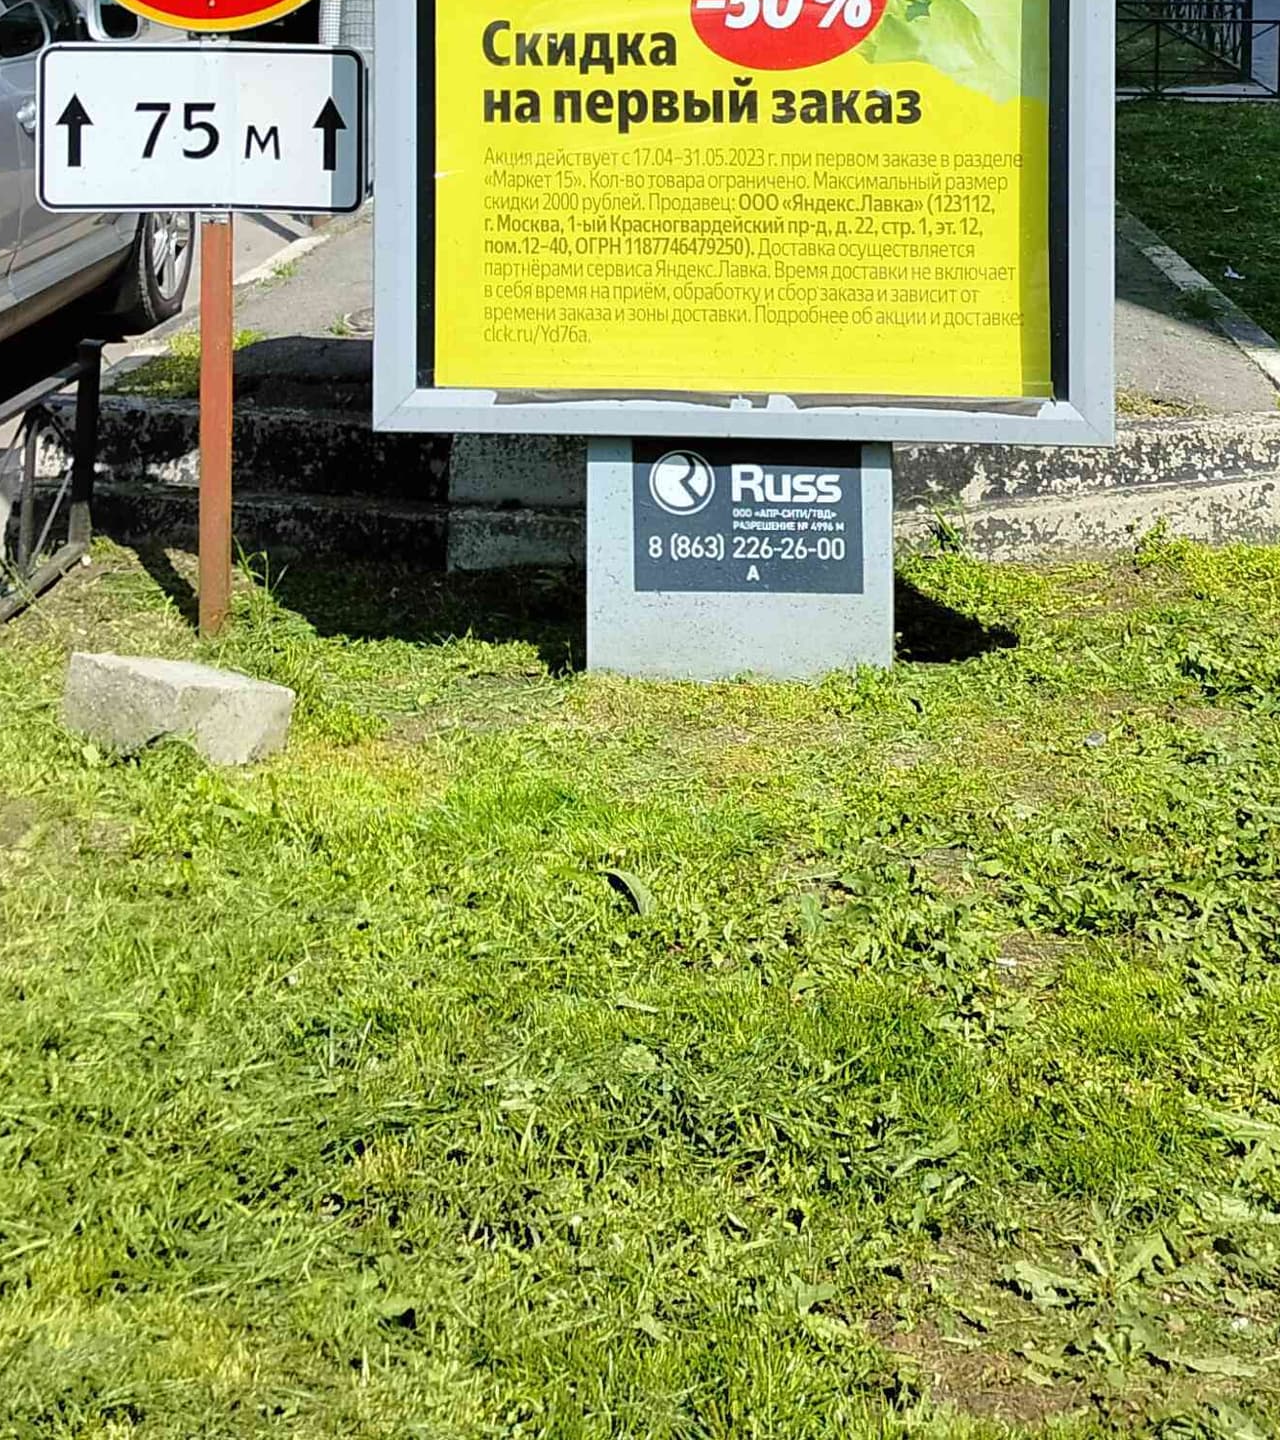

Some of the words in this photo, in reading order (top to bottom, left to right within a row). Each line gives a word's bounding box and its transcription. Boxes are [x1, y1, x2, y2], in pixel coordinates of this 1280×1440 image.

[483, 21, 677, 71] Скидка
[483, 87, 540, 123] на
[554, 77, 757, 133] первый
[772, 87, 922, 125] заказ
[134, 102, 221, 160] 75
[484, 147, 536, 167] Акция
[535, 150, 619, 169] действует
[622, 153, 630, 165] с
[768, 154, 779, 166] г.
[781, 154, 811, 168] при
[816, 154, 879, 168] первом
[884, 155, 936, 167] заказе
[941, 155, 949, 167] в
[954, 155, 1023, 170] разделе
[484, 171, 551, 192] «Маркет
[556, 171, 585, 189] 15».
[589, 172, 645, 189] Кол-во
[648, 175, 704, 190] товара
[708, 175, 810, 190] ограничено.
[813, 172, 940, 189] Максимальный
[945, 176, 1008, 193] размер
[484, 195, 539, 211] скидки
[542, 193, 578, 210] 2000
[582, 194, 645, 214] рублей.
[649, 193, 736, 212] Продавец:
[739, 194, 779, 210] ООО
[783, 195, 923, 214] «Яндекс.Лавка»
[927, 194, 995, 215] (123112,
[484, 219, 493, 231] г.
[497, 215, 564, 235] Москва,
[568, 215, 606, 233] 1-ый
[611, 215, 784, 236] Красногвардейский
[788, 220, 833, 236] пр-д,
[835, 221, 852, 236] д.
[855, 218, 878, 236] 22,
[882, 221, 915, 238] стр.
[919, 218, 932, 236] 1,
[936, 221, 956, 235] эт.
[962, 218, 983, 236] 12,
[576, 238, 621, 254] ОГРН
[758, 238, 835, 257] Доставка
[839, 243, 975, 261] осуществляется
[484, 260, 584, 281] партнёрами
[587, 263, 652, 281] сервиса
[656, 260, 771, 281] Яндекс.Лавка.
[775, 261, 828, 281] Время
[831, 265, 907, 281] доставки
[911, 267, 931, 280] не
[936, 267, 1016, 281] включает
[484, 285, 493, 297] в
[496, 283, 532, 298] себя
[535, 286, 586, 302] время
[591, 286, 609, 299] на
[613, 284, 670, 302] приём,
[673, 283, 761, 303] обработку
[764, 289, 774, 301] и
[778, 286, 818, 303] сбор
[821, 289, 874, 302] заказа
[877, 290, 888, 302] и
[891, 290, 957, 302] зависит
[961, 290, 980, 302] от
[484, 307, 556, 323] времени
[559, 308, 611, 321] заказа
[615, 308, 624, 321] и
[628, 308, 668, 321] зоны
[672, 308, 751, 324] доставки.
[755, 306, 848, 326] Подробнее
[852, 307, 872, 324] об
[876, 312, 926, 327] акции
[929, 313, 941, 325] и
[731, 464, 842, 503] Russ
[649, 536, 662, 558] 8
[670, 534, 724, 561] (863)
[732, 537, 845, 560] 226-26-00
